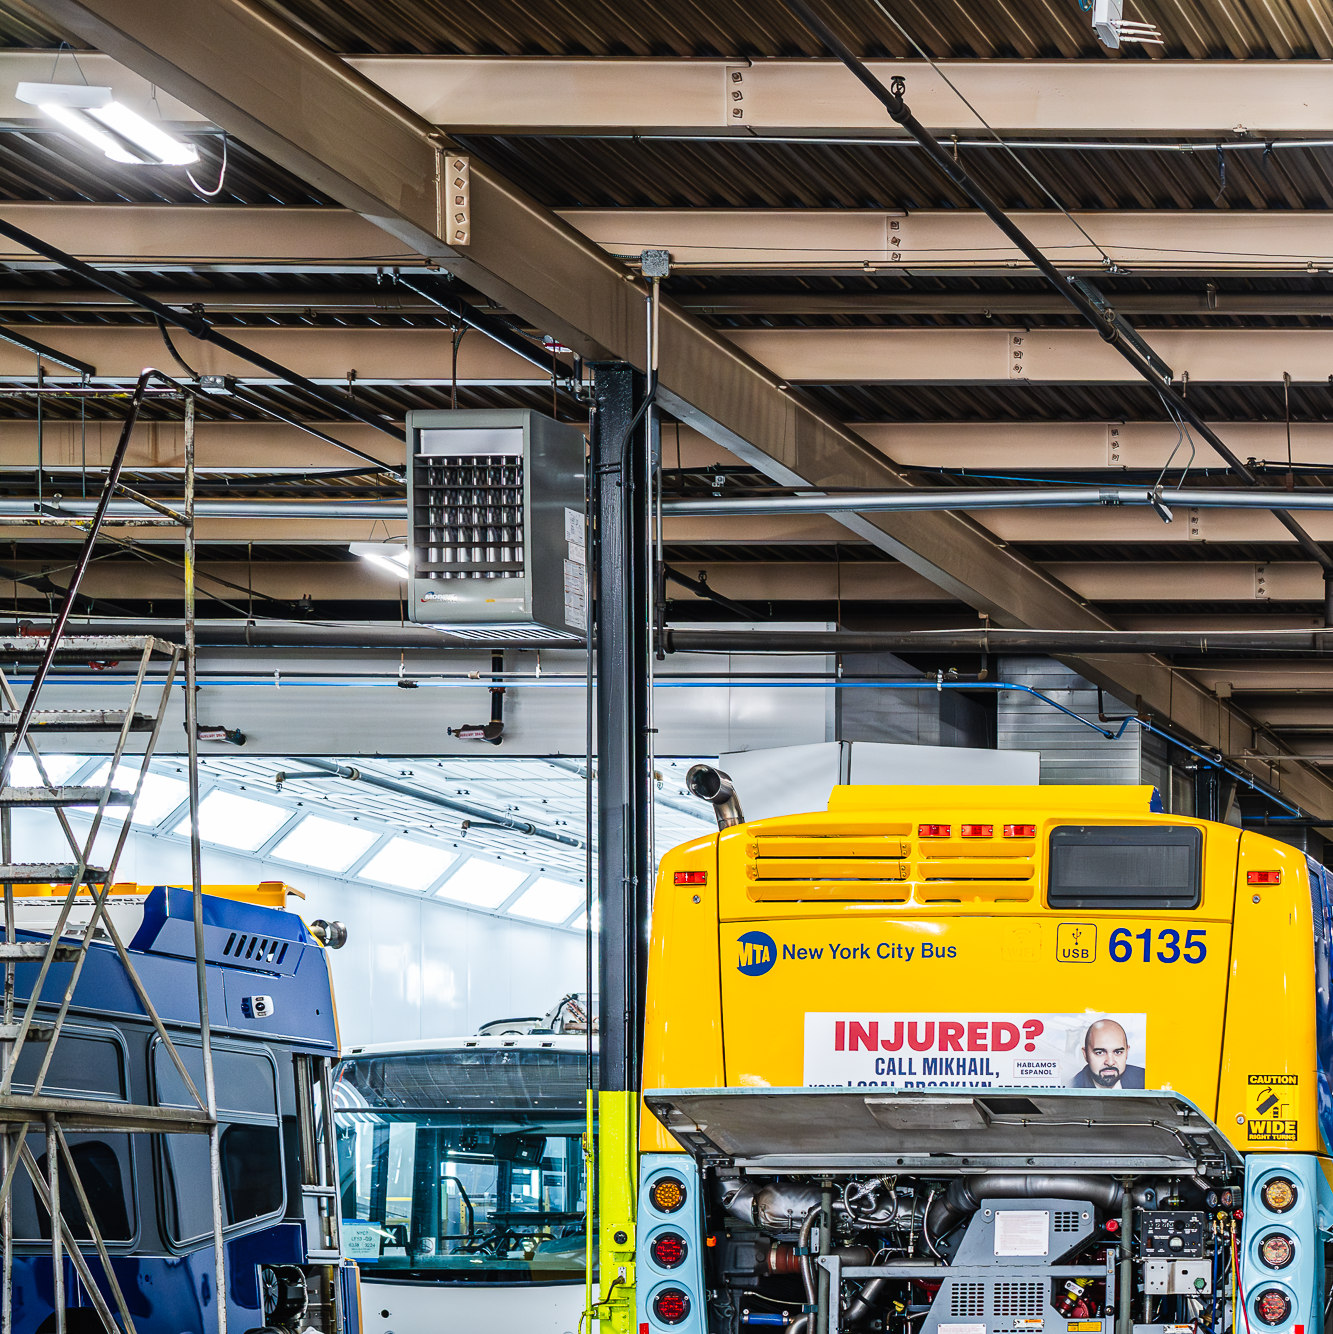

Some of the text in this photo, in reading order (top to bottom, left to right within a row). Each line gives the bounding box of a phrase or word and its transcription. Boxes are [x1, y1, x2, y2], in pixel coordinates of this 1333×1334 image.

[783, 942, 957, 962] New York City Bus
[1062, 948, 1089, 959] USB
[1109, 928, 1207, 964] 6135
[834, 1019, 1045, 1053] INJURED?
[875, 1057, 1000, 1079] CALL MIKHAIL,
[1249, 1075, 1297, 1084] CAUTION
[1249, 1121, 1296, 1134] WIDE
